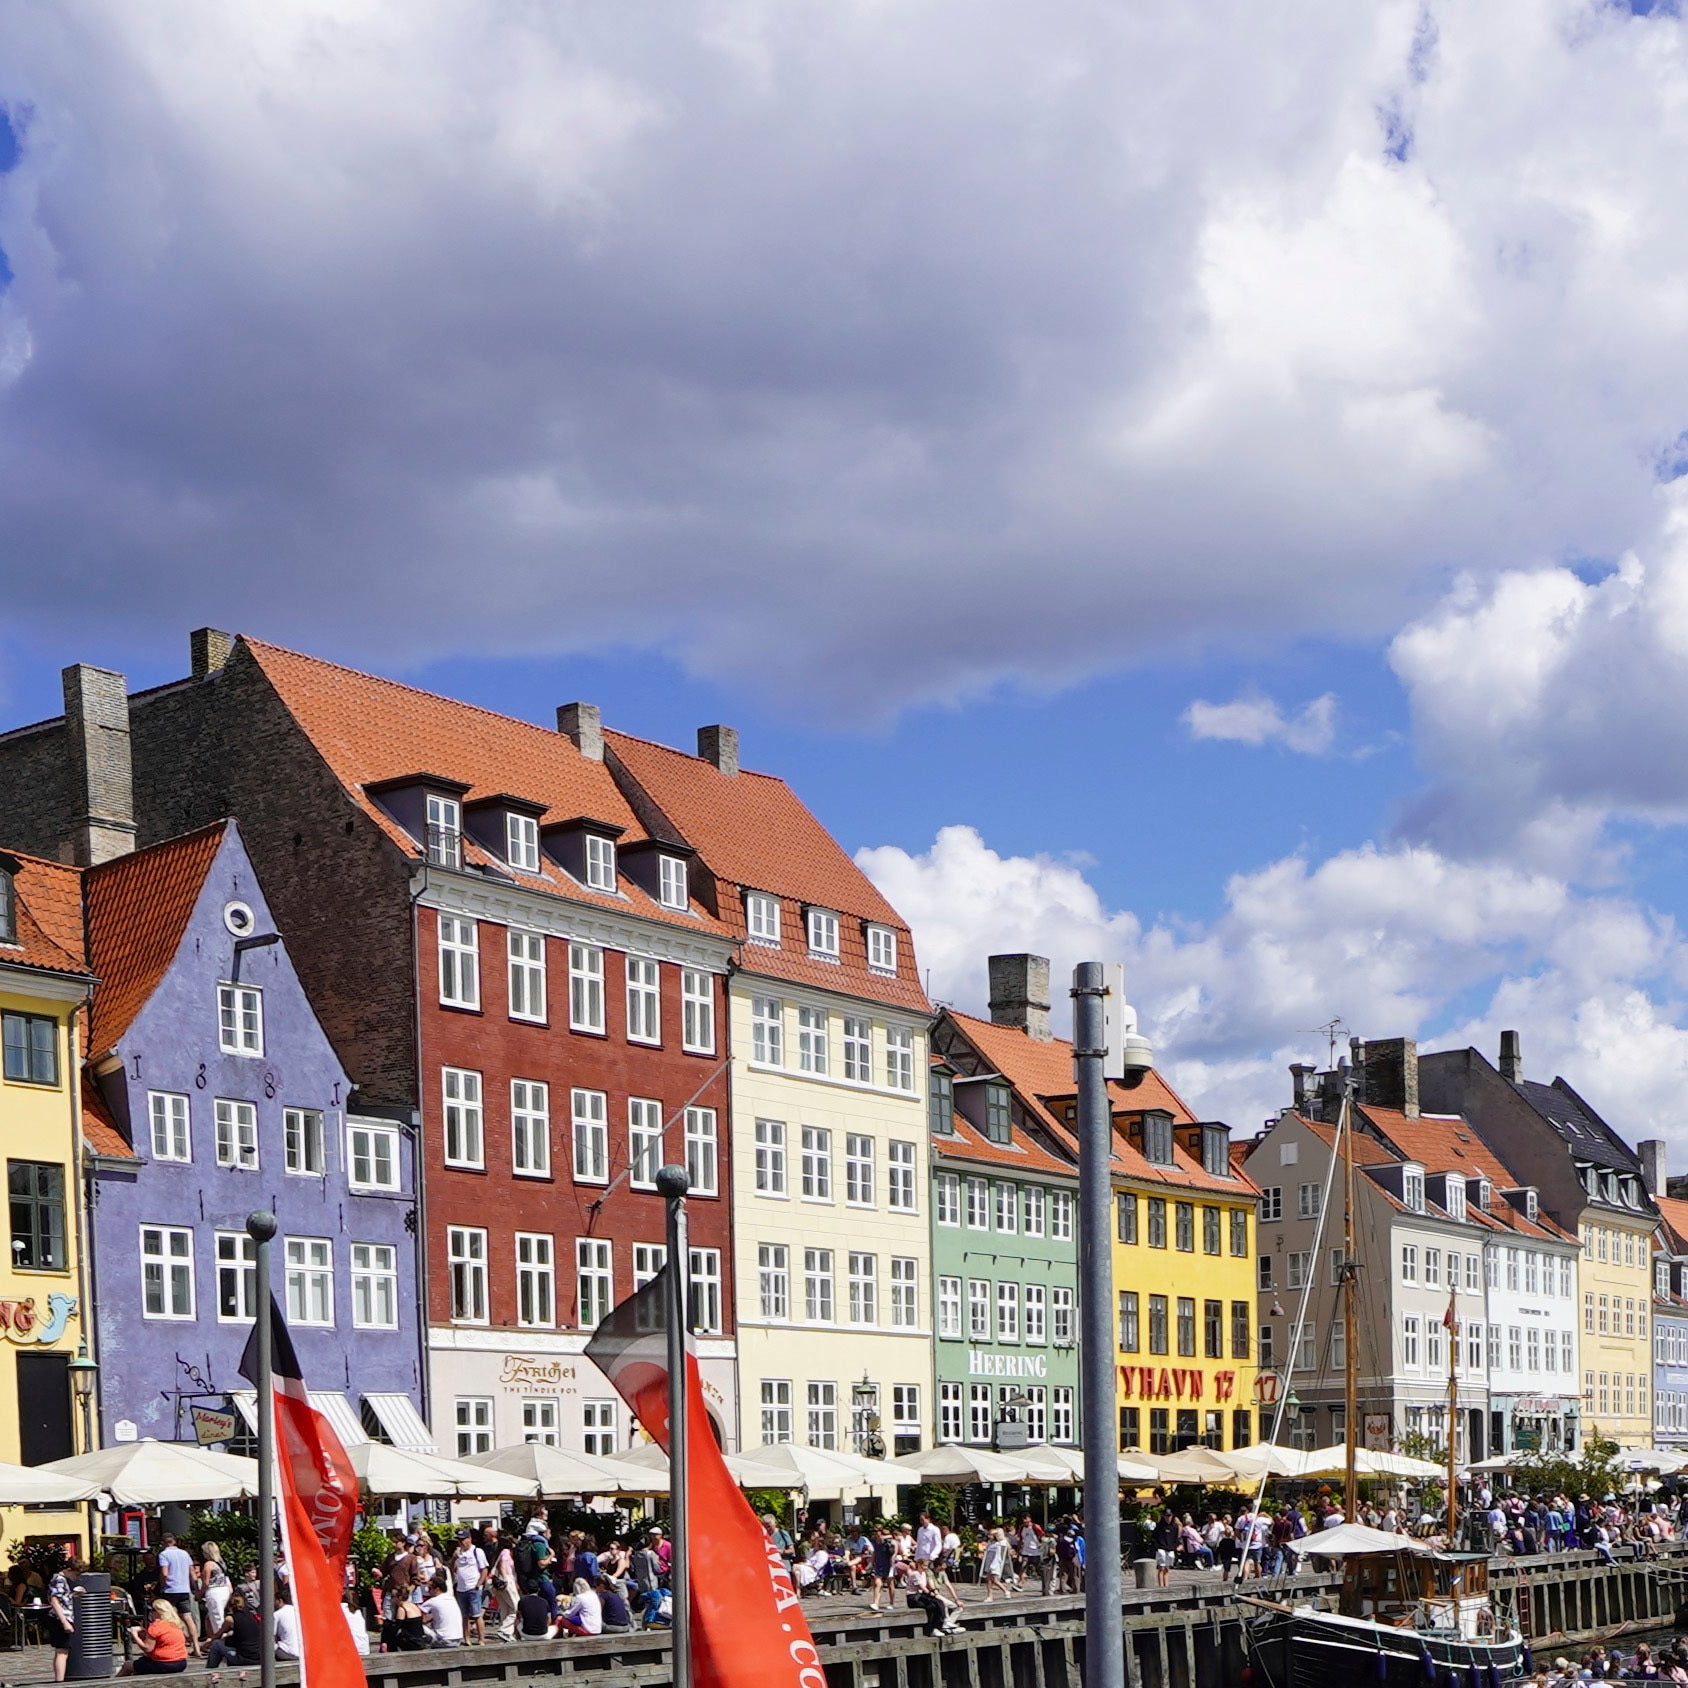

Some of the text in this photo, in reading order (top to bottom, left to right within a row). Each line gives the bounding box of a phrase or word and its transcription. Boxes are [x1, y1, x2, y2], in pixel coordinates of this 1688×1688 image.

[968, 1350, 1048, 1378] HEERING
[1115, 1365, 1236, 1399] YHAVN 17
[1254, 1375, 1277, 1401] 17
